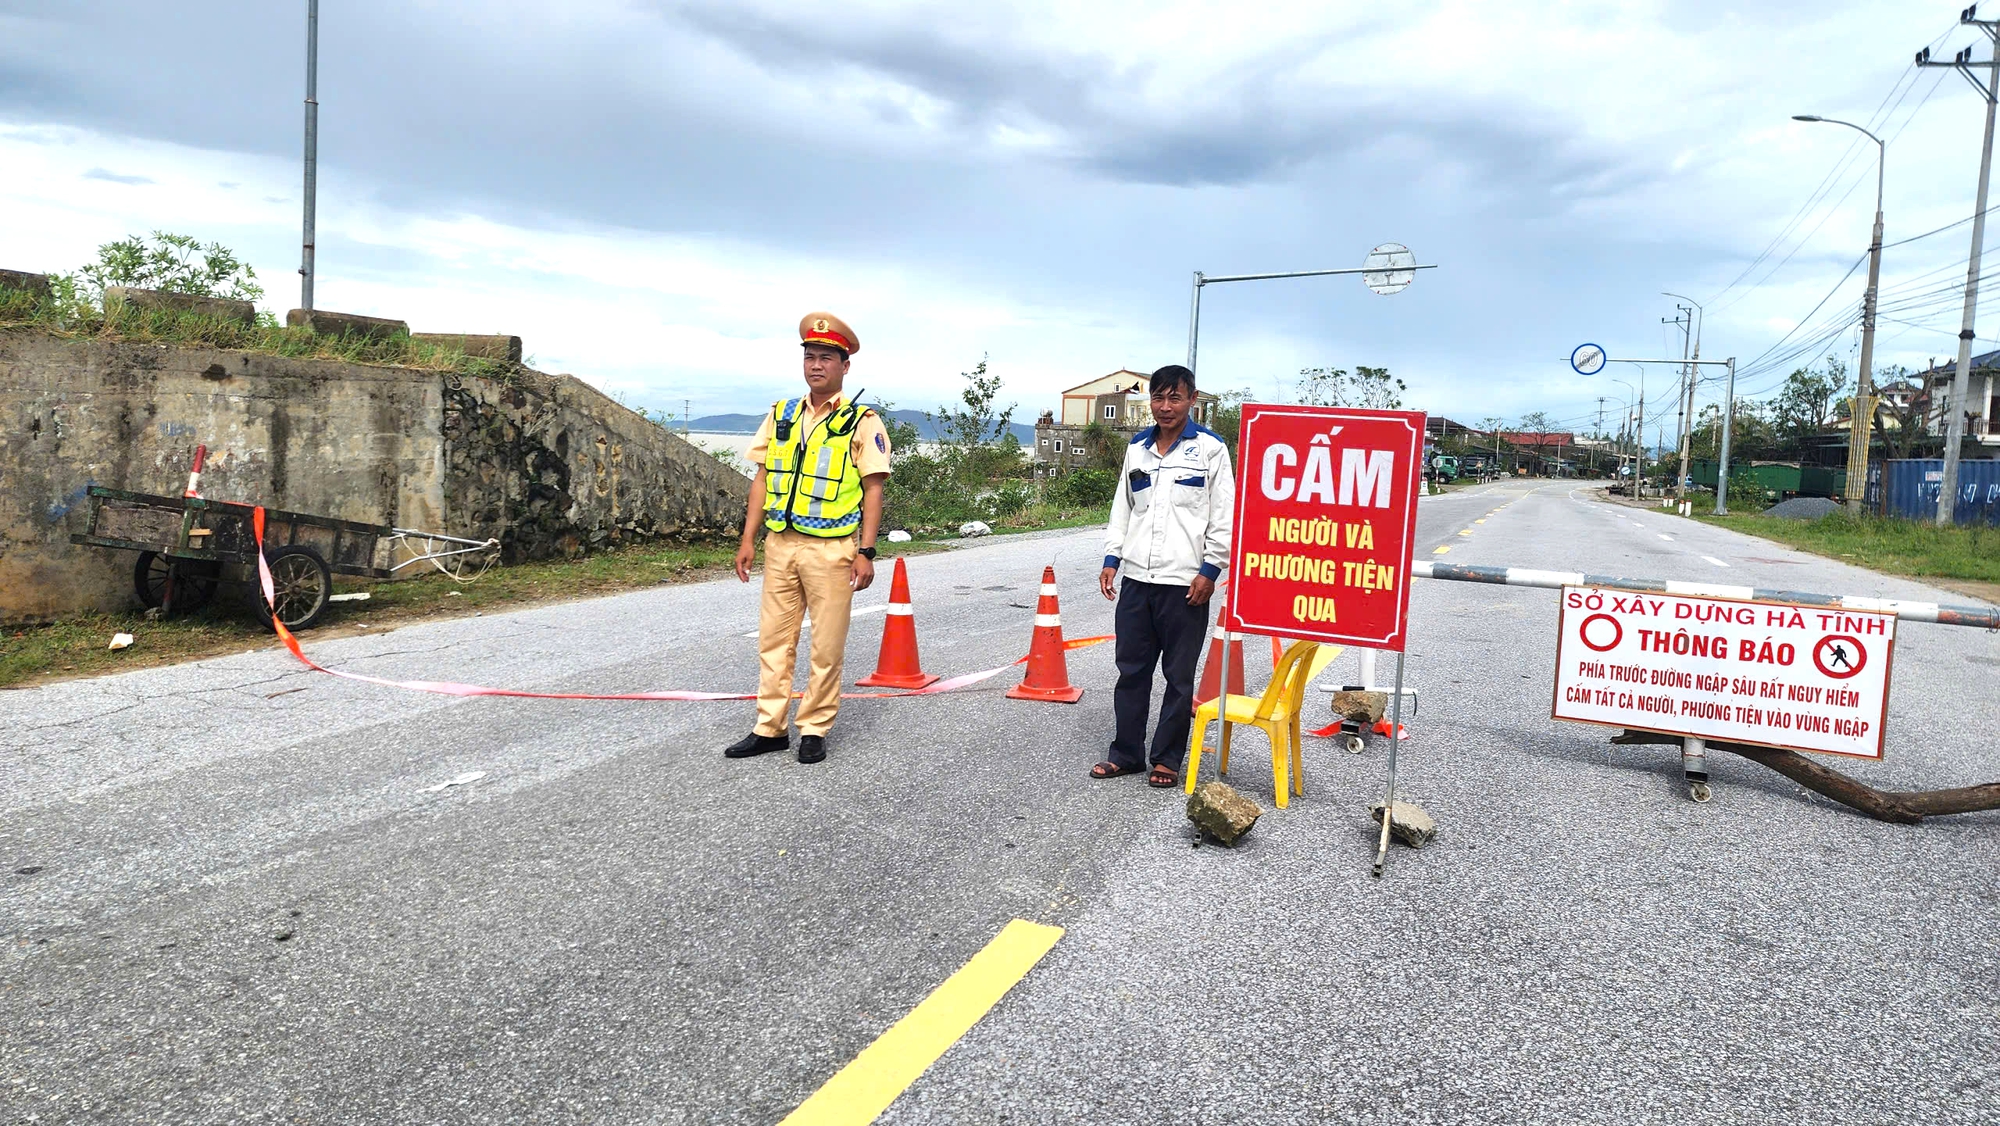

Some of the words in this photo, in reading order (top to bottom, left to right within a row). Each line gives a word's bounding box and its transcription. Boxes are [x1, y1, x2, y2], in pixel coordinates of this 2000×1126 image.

[1260, 425, 1395, 509] CẤM
[1268, 515, 1338, 547] NGƯỜI
[1345, 519, 1374, 550] VÀ
[1244, 552, 1336, 585] PHƯƠNG
[1343, 558, 1395, 594] TIỆN
[1293, 594, 1337, 624] QUA
[1567, 588, 1604, 611] SỞ
[1611, 594, 1665, 617] XÂY
[1675, 602, 1755, 625] DỰNG
[1766, 606, 1806, 630] HÀ
[1816, 611, 1885, 636] TĨNH
[1637, 627, 1728, 660] THÔNG
[1738, 635, 1796, 667] BÁO
[1578, 659, 1605, 679] PHÍA
[1609, 663, 1648, 684] TRƯỚC
[1650, 667, 1692, 689] ĐƯỜNG
[1695, 672, 1729, 696] NGẬP
[1731, 675, 1757, 697] SÂU
[1760, 676, 1785, 700] RẤT
[1787, 684, 1823, 704] NGUY
[1825, 683, 1860, 708] HIỂM
[1566, 683, 1592, 704] CẤM
[1595, 686, 1616, 707] TẤT
[1618, 689, 1634, 710] CẢ
[1637, 694, 1677, 717] NGƯỜI,
[1681, 700, 1731, 722] PHƯƠNG
[1735, 704, 1763, 728] TIỆN
[1766, 707, 1792, 729] VÀO
[1795, 710, 1830, 734] VÙNG
[1834, 716, 1870, 741] NGẬP
